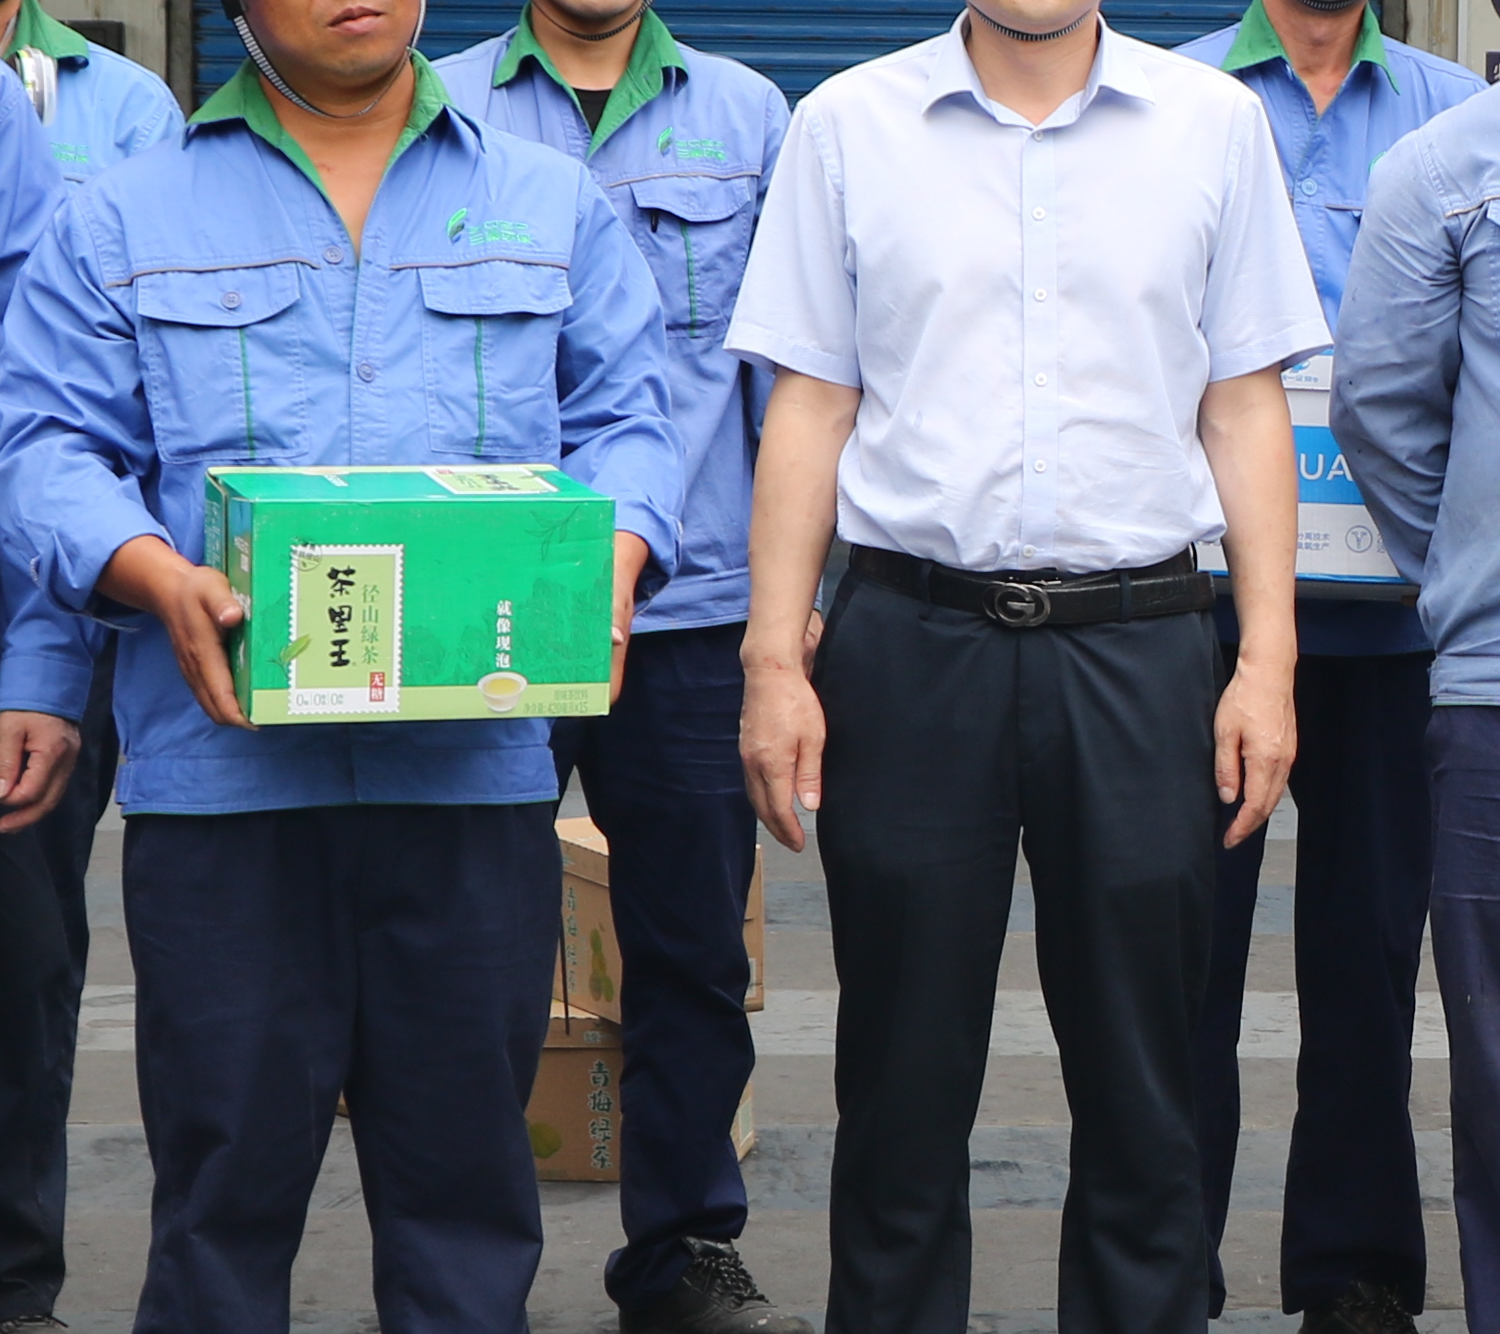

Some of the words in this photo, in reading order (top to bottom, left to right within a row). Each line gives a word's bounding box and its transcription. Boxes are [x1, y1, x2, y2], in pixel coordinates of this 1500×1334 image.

[327, 566, 356, 667] 茶里王
[361, 584, 380, 665] 径山绿茶
[496, 600, 512, 668] 就像现泡
[371, 674, 383, 700] 无糖
[589, 1060, 613, 1169] 青梅绿茶
